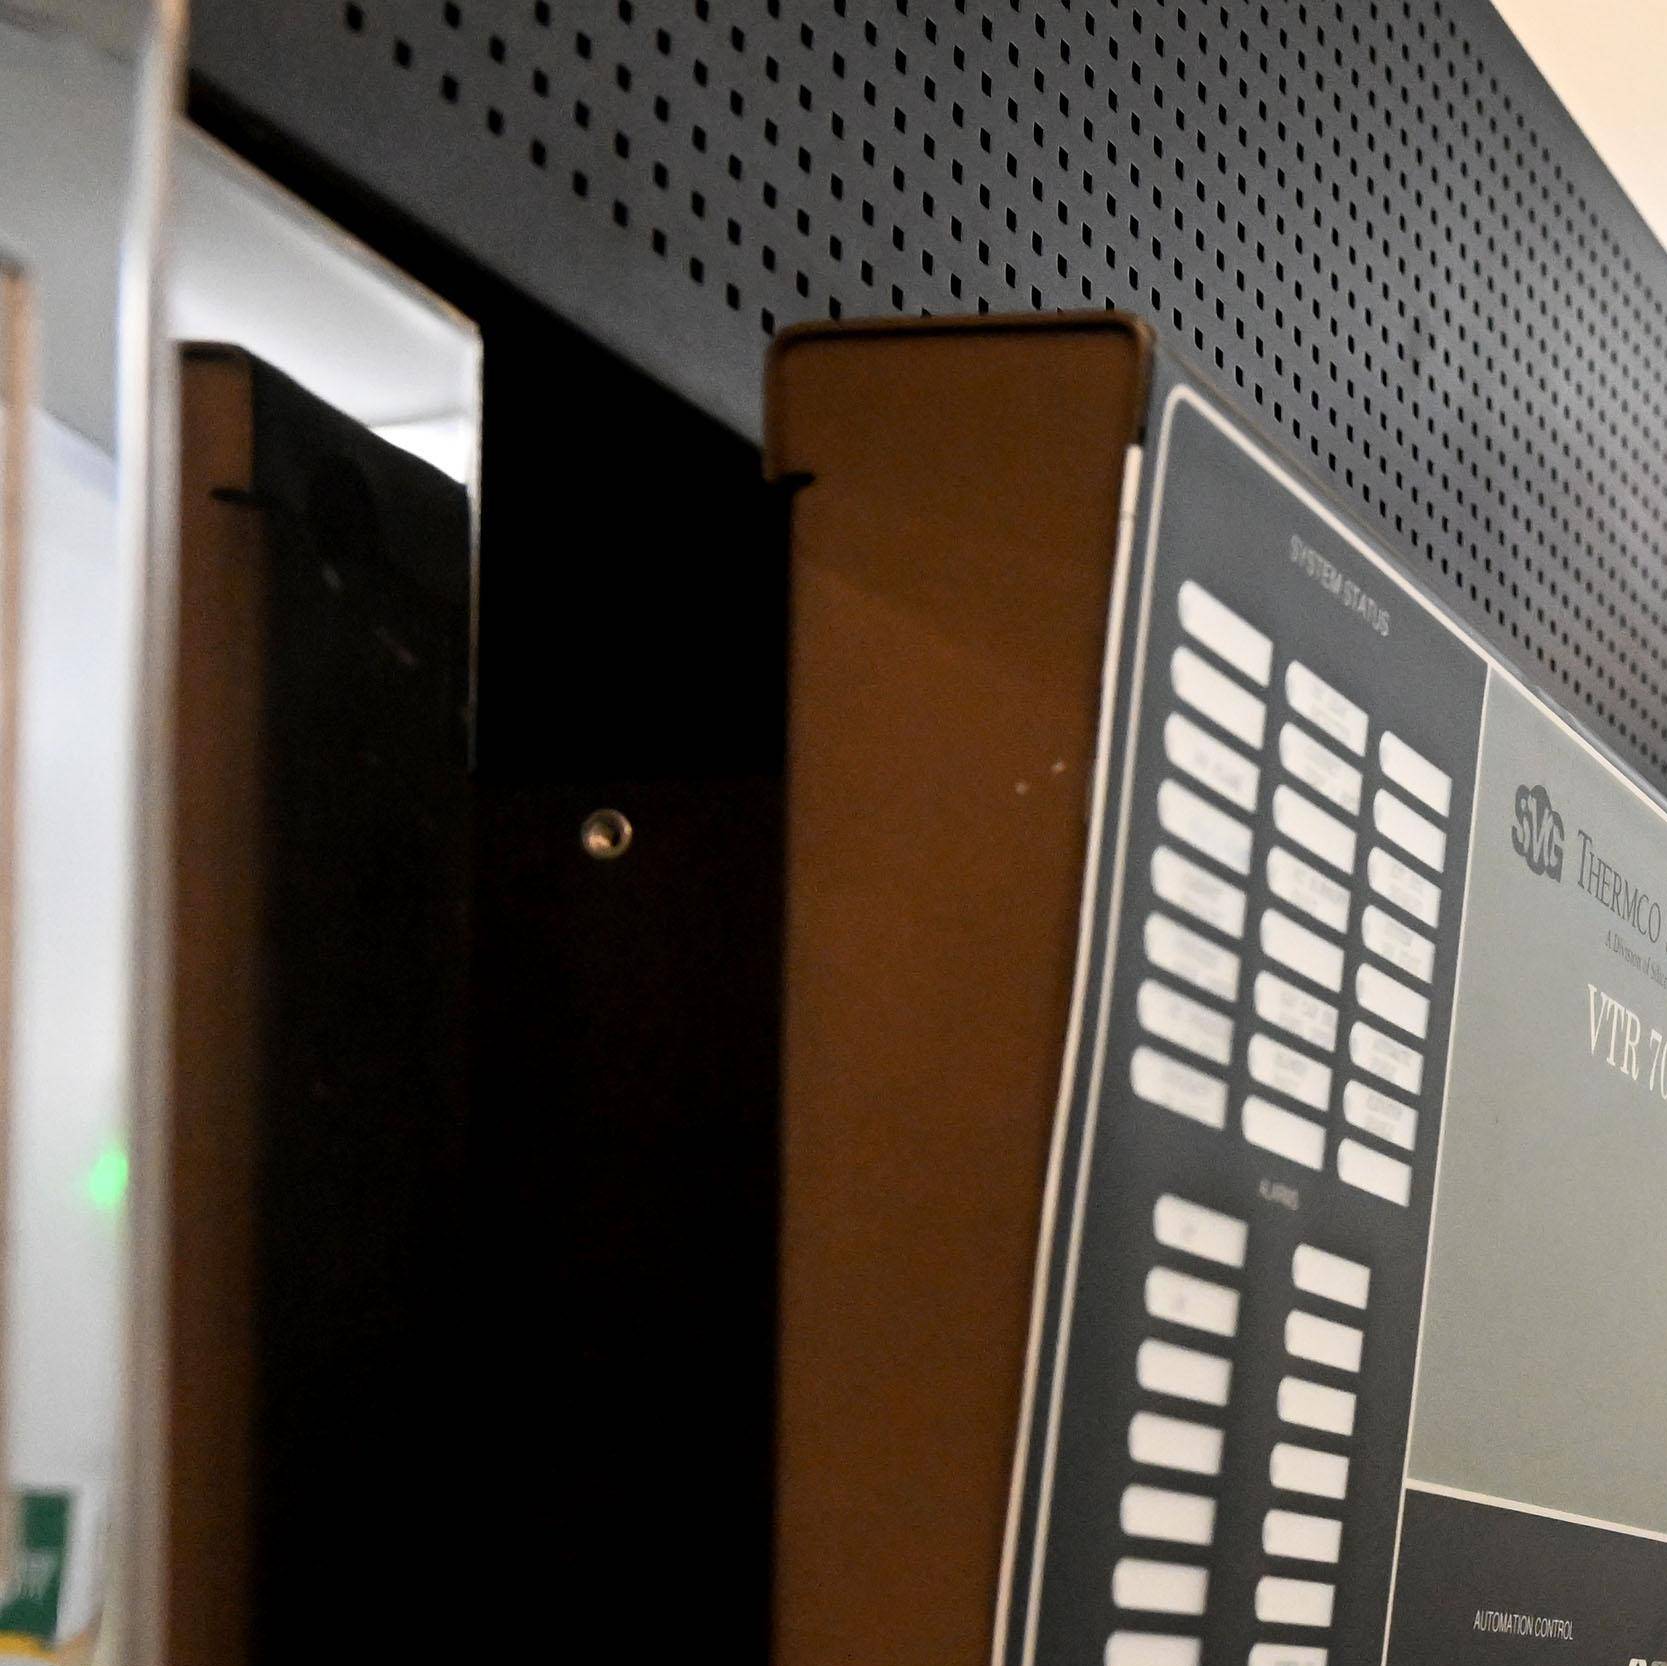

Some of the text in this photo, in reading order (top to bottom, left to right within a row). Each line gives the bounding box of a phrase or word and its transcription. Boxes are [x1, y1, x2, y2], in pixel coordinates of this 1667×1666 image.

[1290, 533, 1390, 637] SYSTEM STATUS
[1511, 784, 1566, 884] SVG
[1587, 983, 1641, 1081] VTR
[1473, 1609, 1574, 1641] AUTOMATION CONTROL
